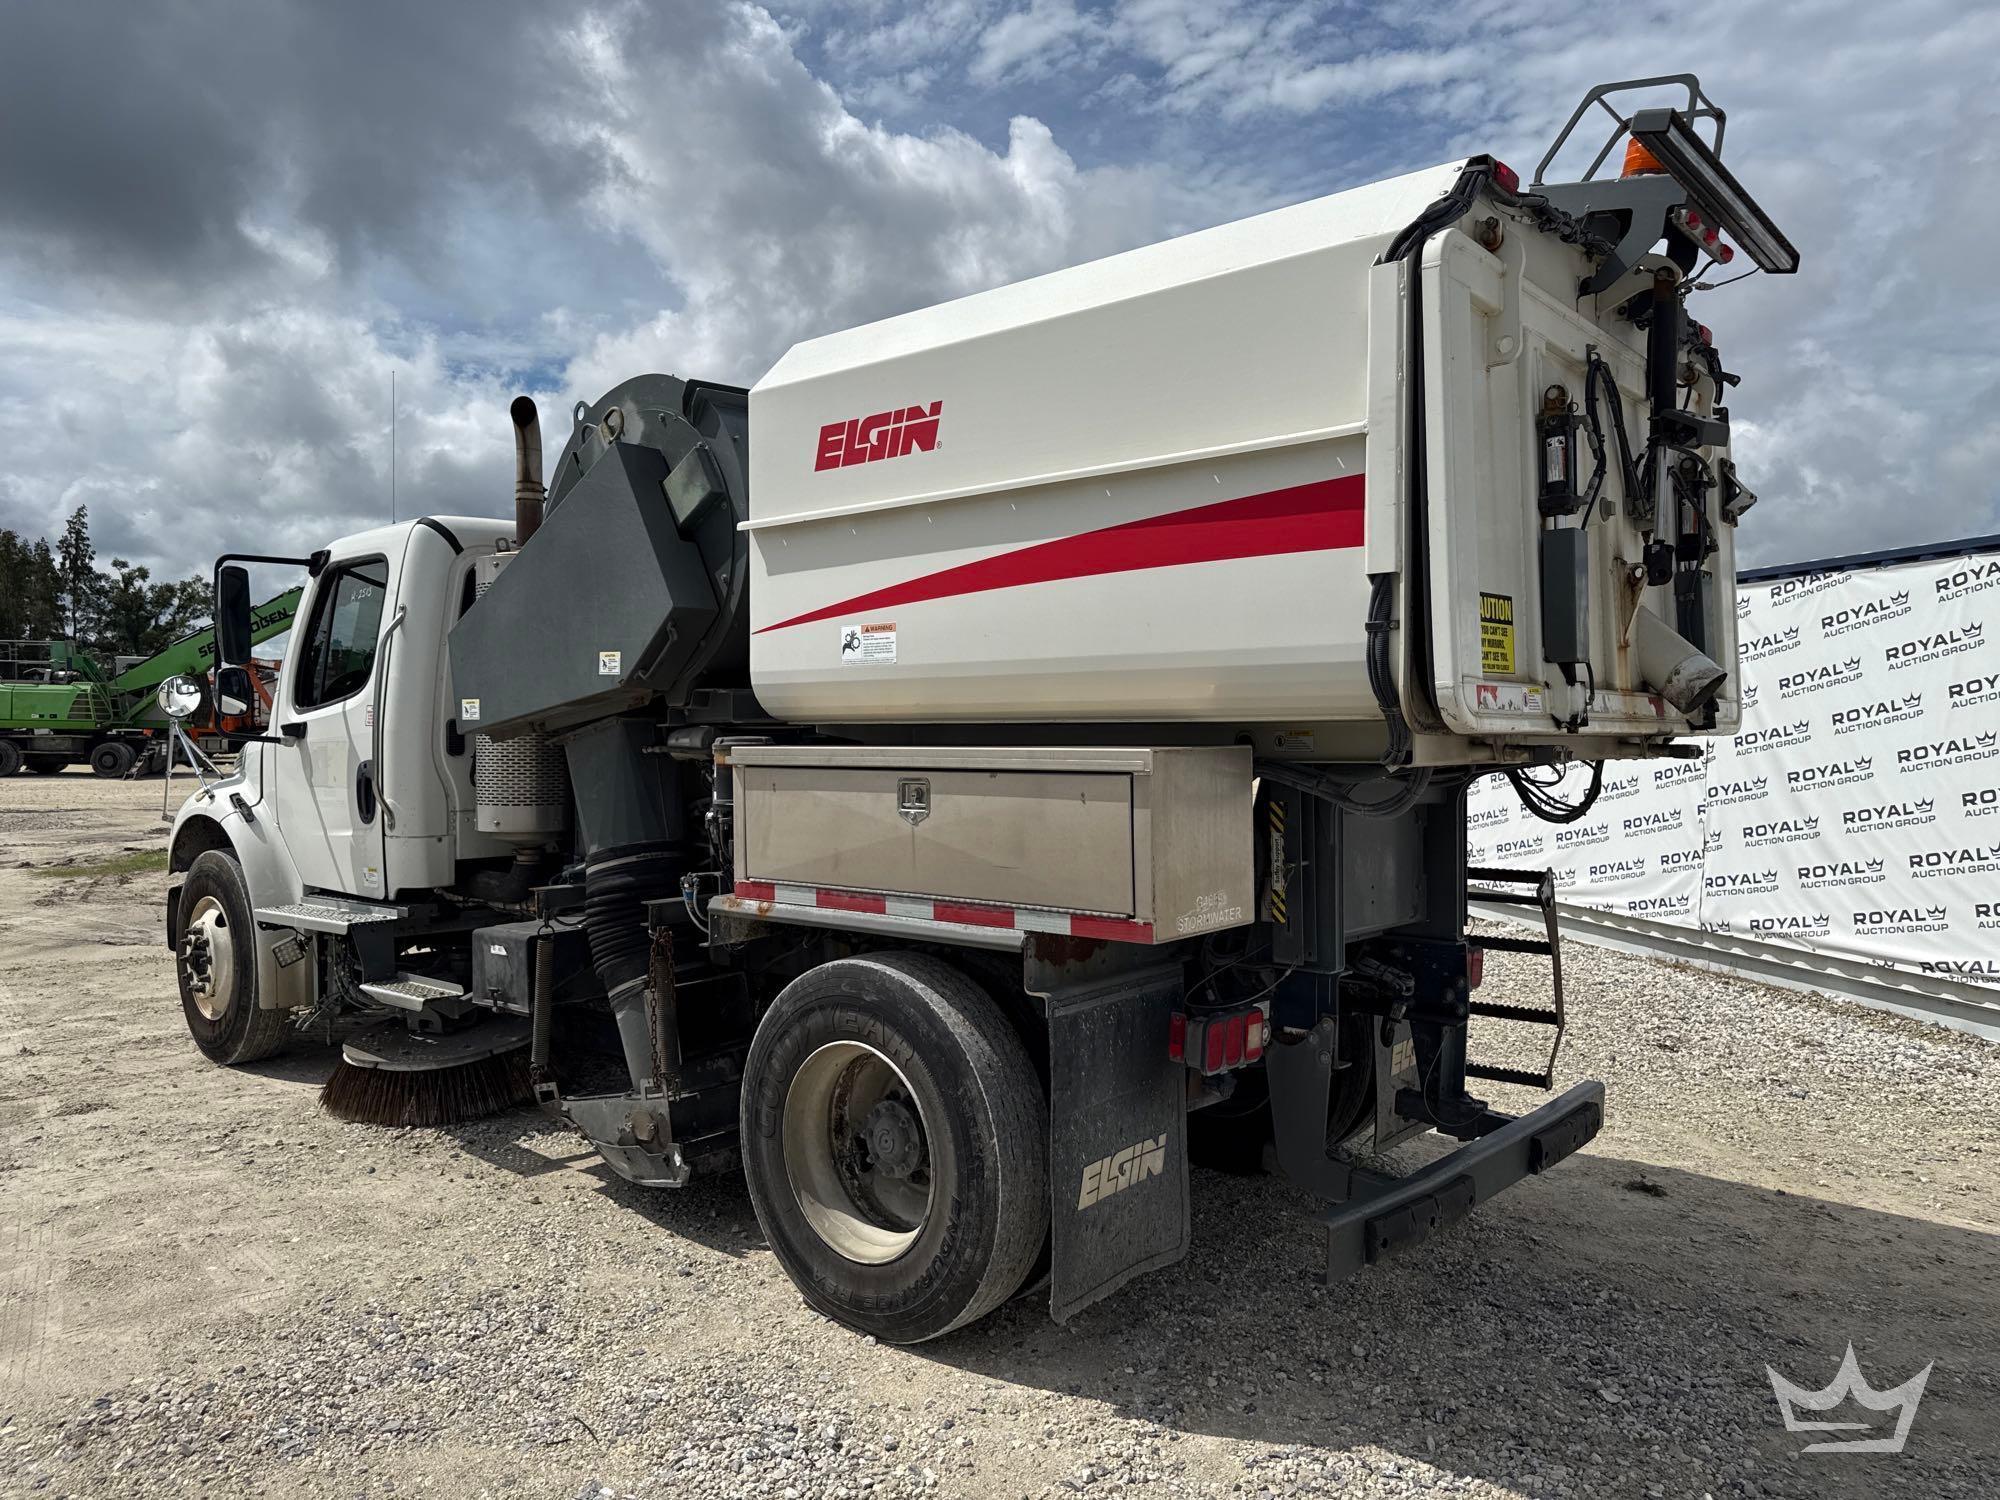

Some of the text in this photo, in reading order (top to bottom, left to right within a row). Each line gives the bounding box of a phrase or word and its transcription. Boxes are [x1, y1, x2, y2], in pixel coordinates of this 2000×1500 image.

[815, 400, 943, 472] ELGIN
[1935, 561, 2000, 594] ROYA
[1771, 574, 1852, 608] AUCTION GROUP
[1937, 581, 1994, 604] AUCTION
[1480, 597, 1512, 621] AUTION
[1821, 599, 1890, 630] ROYAL
[1823, 606, 1912, 640] AUCTION GROUP
[198, 607, 290, 659] SEOGEN
[1738, 633, 1783, 655] OYAL
[1740, 640, 1801, 664] CTION GROUP
[1885, 630, 1962, 661] ROYAL
[1887, 639, 1985, 672] AUCTION GROUP
[1779, 664, 1843, 690] ROYAL
[1781, 672, 1863, 700] AUCTION GROUP
[1948, 674, 2000, 698] ROY
[1741, 700, 1759, 710] OUP
[1951, 692, 2000, 709] AUCTIO
[1832, 700, 1902, 726] ROYAL
[1834, 709, 1924, 736] AUCTION GROUP
[1734, 726, 1793, 748] ROYAL
[1735, 735, 1811, 757] AUCTION GROUP
[1897, 738, 1976, 763] ROYAL
[1899, 749, 2000, 774] AUCTION GROUP
[1654, 762, 1701, 782] ROYAL
[1787, 761, 1854, 784] ROYAL
[1602, 780, 1627, 794] YAL
[1655, 773, 1707, 790] AUCTION GRO
[1707, 781, 1753, 798] OYAL
[1790, 772, 1875, 794] AUCTION GROUP
[1615, 788, 1640, 800] GROUP
[1738, 791, 1769, 803] GROUP
[1467, 809, 1500, 824] ROYAL
[1843, 803, 1914, 825] ROYAL
[1964, 805, 2000, 818] AUCT
[1490, 817, 1510, 826] GROUP
[1623, 812, 1670, 830] ROYAL
[1624, 822, 1683, 838] AUCTION GROUP
[1743, 820, 1804, 838] ROYAL
[1845, 815, 1936, 835] AUCTION GROUP
[1555, 826, 1598, 842] ROYAL
[1557, 835, 1610, 850] AUCTION GROUP
[1744, 831, 1821, 848] AUCTION GROUP
[1496, 838, 1533, 853] ROYAL
[1497, 848, 1544, 860] AUCTION GROUP
[1660, 849, 1705, 866] ROYA
[1909, 848, 1990, 868] ROYAL
[1589, 861, 1633, 876] ROYAL
[1590, 870, 1646, 884] AUCTION GROUP
[1661, 864, 1696, 874] AUCTION
[1798, 861, 1866, 879] ROYAL
[1911, 862, 2000, 878] AUCTION GROU
[1704, 873, 1762, 889] ROYAL
[1800, 874, 1886, 889] AUCTION GROUP
[1706, 884, 1779, 898] AUCTION GROUP
[1628, 897, 1677, 911] ROYAL
[1664, 908, 1690, 917] GROUP
[1177, 907, 1242, 932] STORMWATER
[1750, 916, 1812, 931] ROYAL
[1853, 908, 1926, 925] ROYAL
[1754, 929, 1831, 942] AUCTION GROUP
[1855, 923, 1949, 936] AUCTION GROUP
[1919, 960, 2000, 974] ROYAL
[1078, 1133, 1167, 1211] ELGIN
